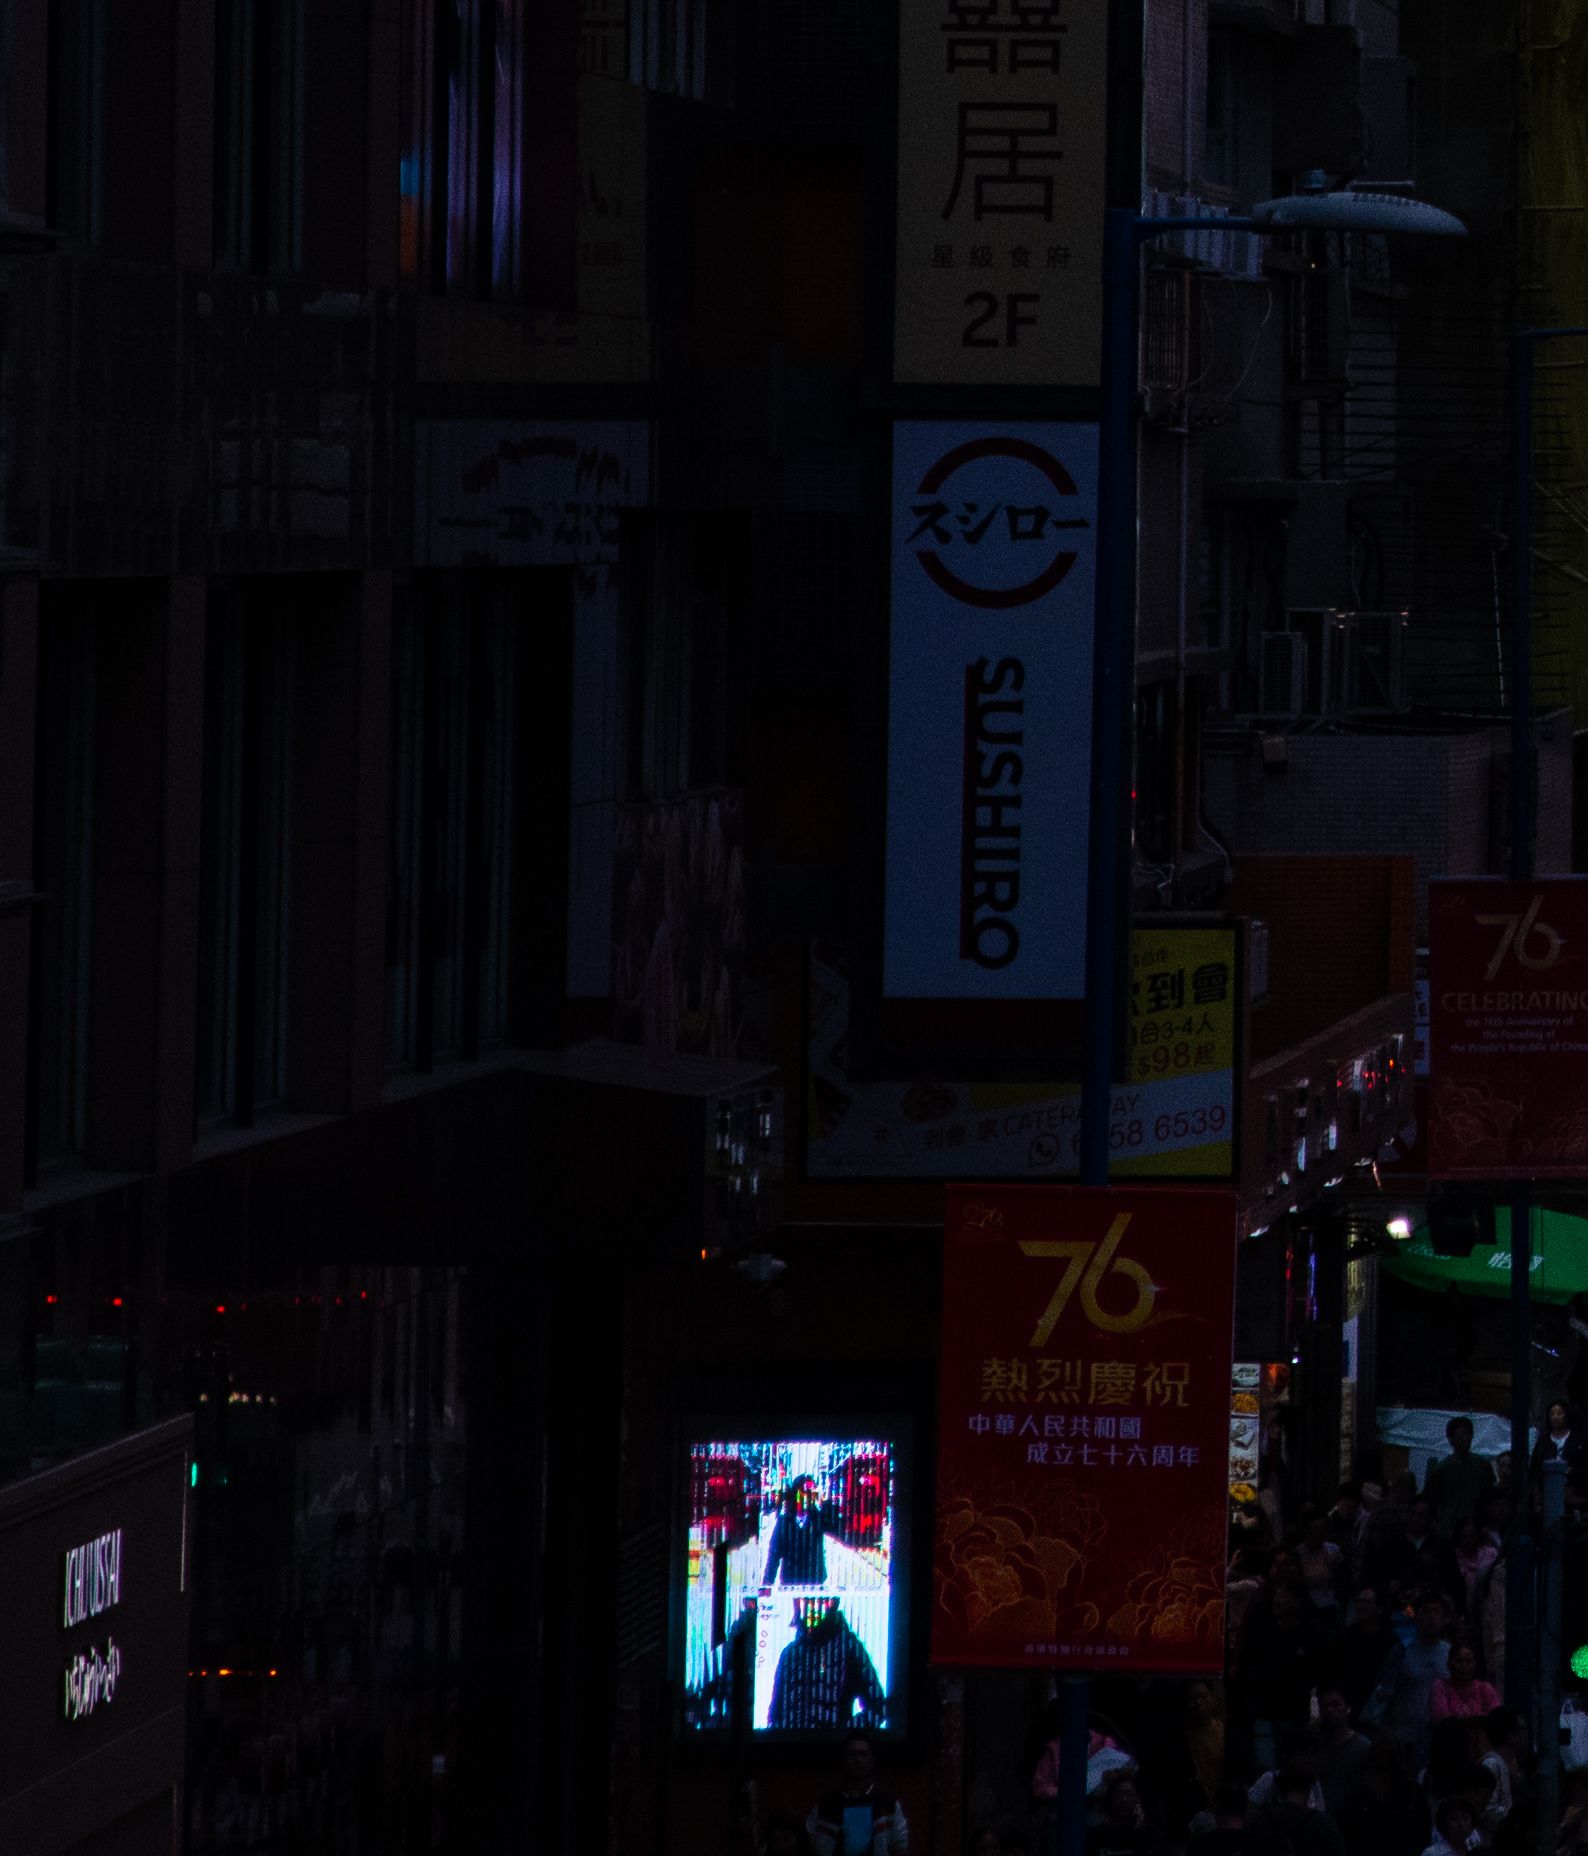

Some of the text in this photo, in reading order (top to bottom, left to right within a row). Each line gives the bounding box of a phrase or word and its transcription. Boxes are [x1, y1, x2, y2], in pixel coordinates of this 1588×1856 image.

[931, 245, 1070, 270] 星級食府
[961, 290, 1041, 348] 2F
[905, 501, 1090, 546] スシロー
[976, 656, 1025, 971] SUSHIRO
[1474, 894, 1561, 982] 76
[1131, 962, 1228, 1016] 到會
[1130, 1012, 1215, 1046] 合3-4人
[1563, 1016, 1574, 1026] of
[1004, 1093, 1140, 1137] CATERAAY
[1071, 1104, 1225, 1155] 658 6539
[1016, 1210, 1157, 1348] 76
[979, 1357, 1191, 1408] 熱烈慶祝
[968, 1413, 1142, 1440] 中華人民共和國
[1026, 1443, 1200, 1468] 成立七十六周年
